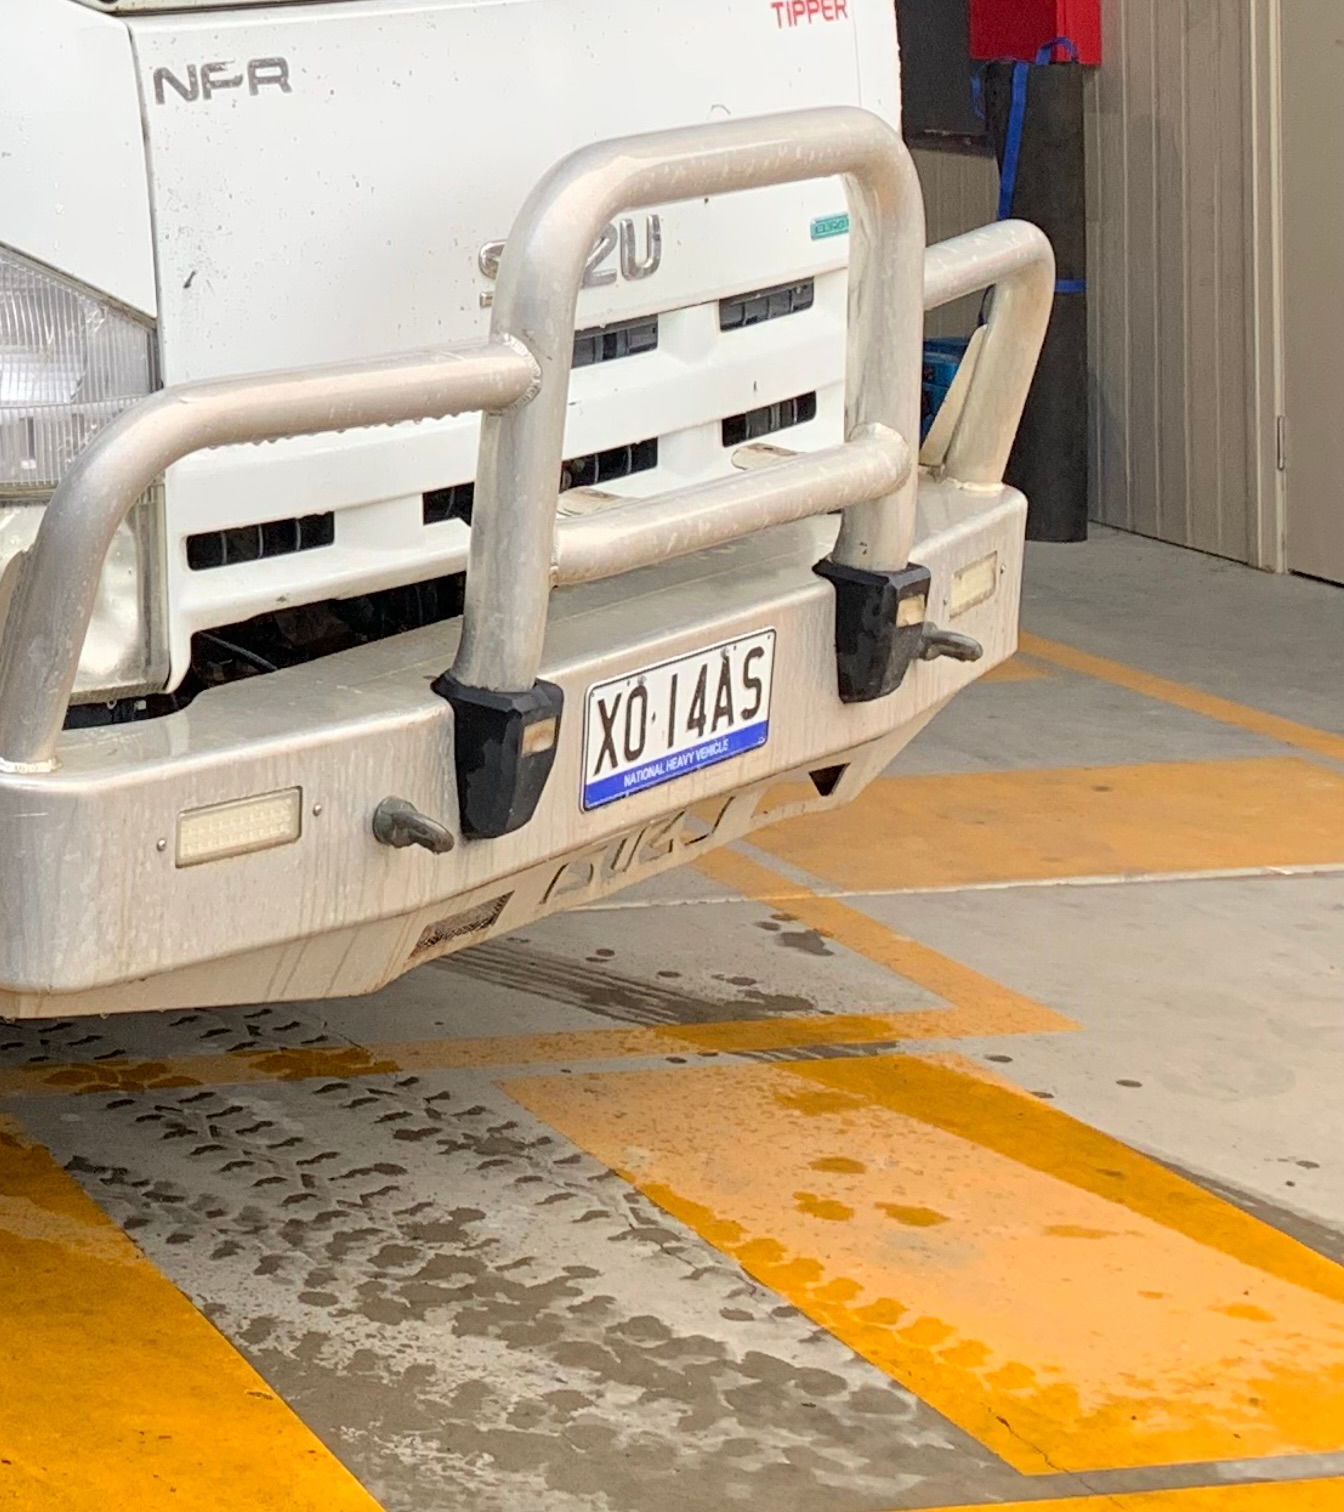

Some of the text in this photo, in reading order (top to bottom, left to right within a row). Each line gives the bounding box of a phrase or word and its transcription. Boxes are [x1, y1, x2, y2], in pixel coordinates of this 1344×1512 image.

[153, 57, 293, 105] NFR
[623, 738, 730, 787] NATIONAL HEAVY VEHICLE
